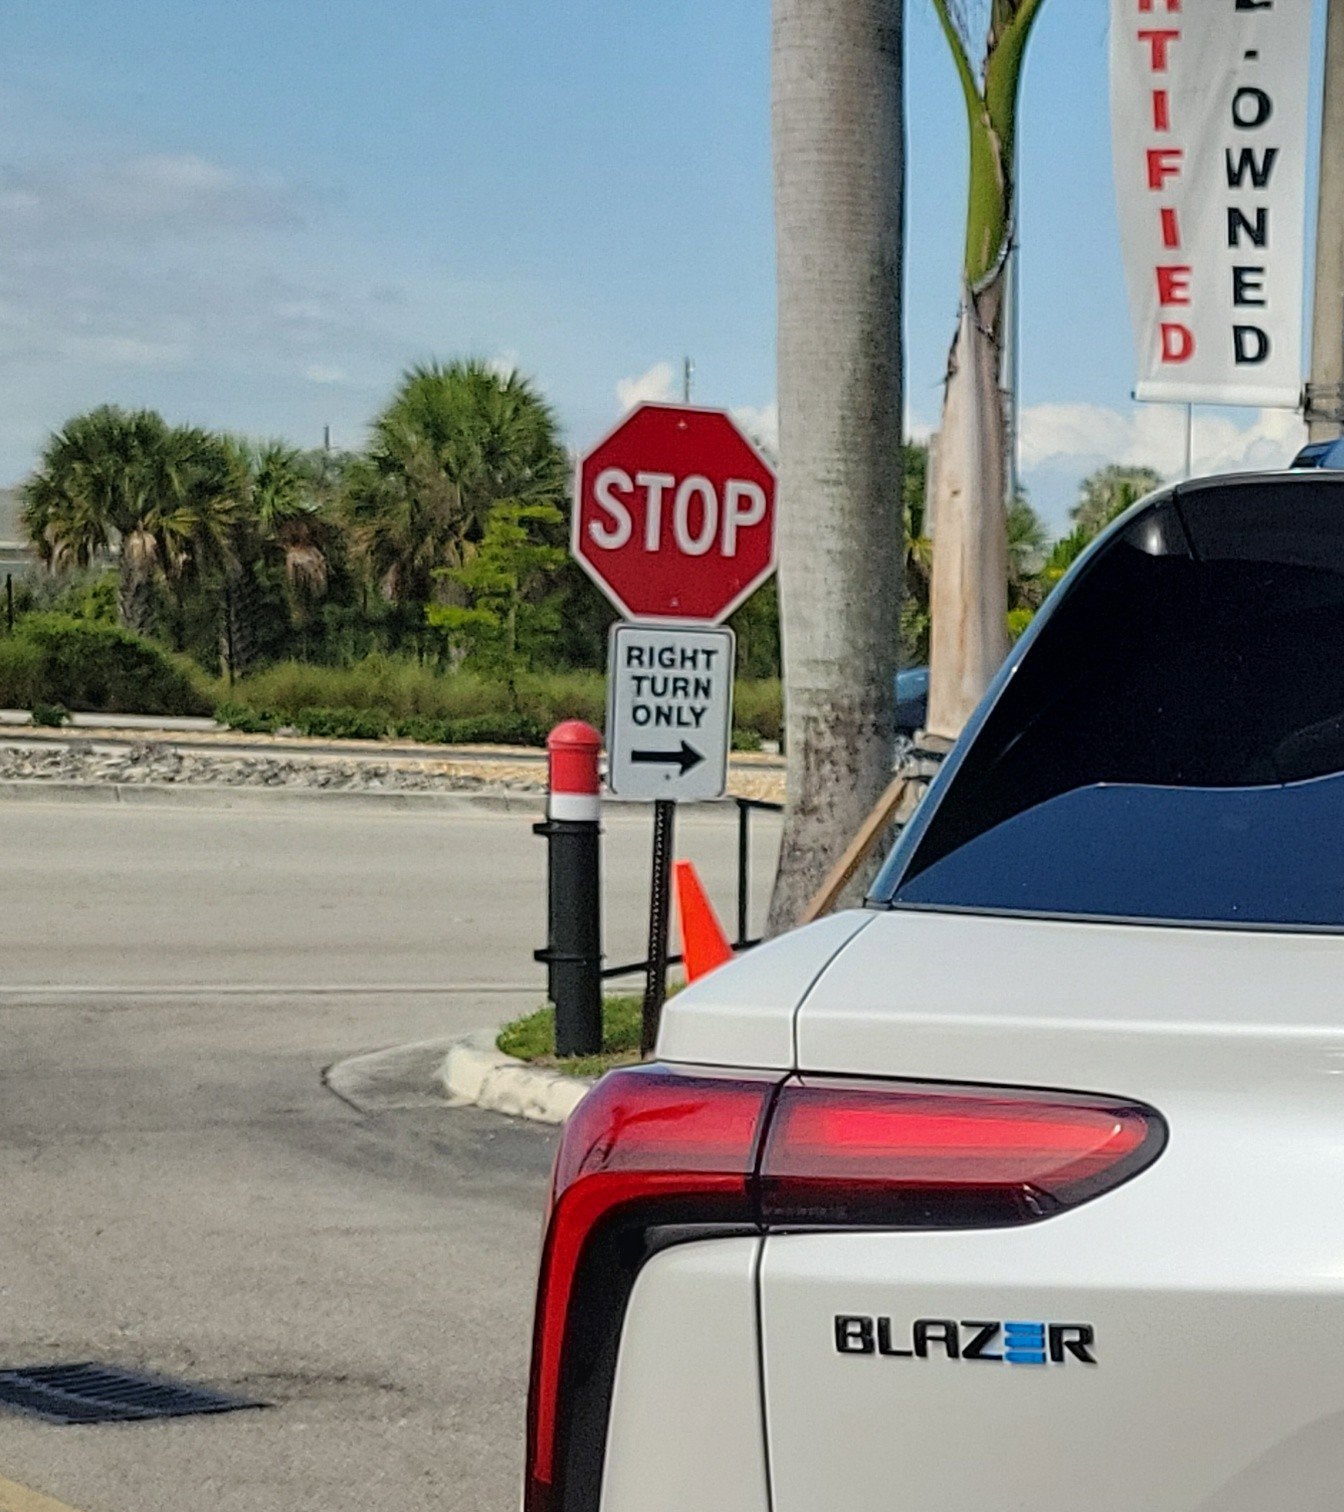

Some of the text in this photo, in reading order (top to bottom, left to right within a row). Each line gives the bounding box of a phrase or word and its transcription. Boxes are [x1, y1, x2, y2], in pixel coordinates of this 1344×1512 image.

[1137, 0, 1195, 365] TIFIED
[1225, 0, 1279, 366] -OWNED
[588, 466, 767, 558] STOP
[626, 645, 719, 670] RIGHT
[632, 675, 712, 699] TURN
[632, 705, 708, 729] ONLY
[834, 1314, 1097, 1364] BLAZER
